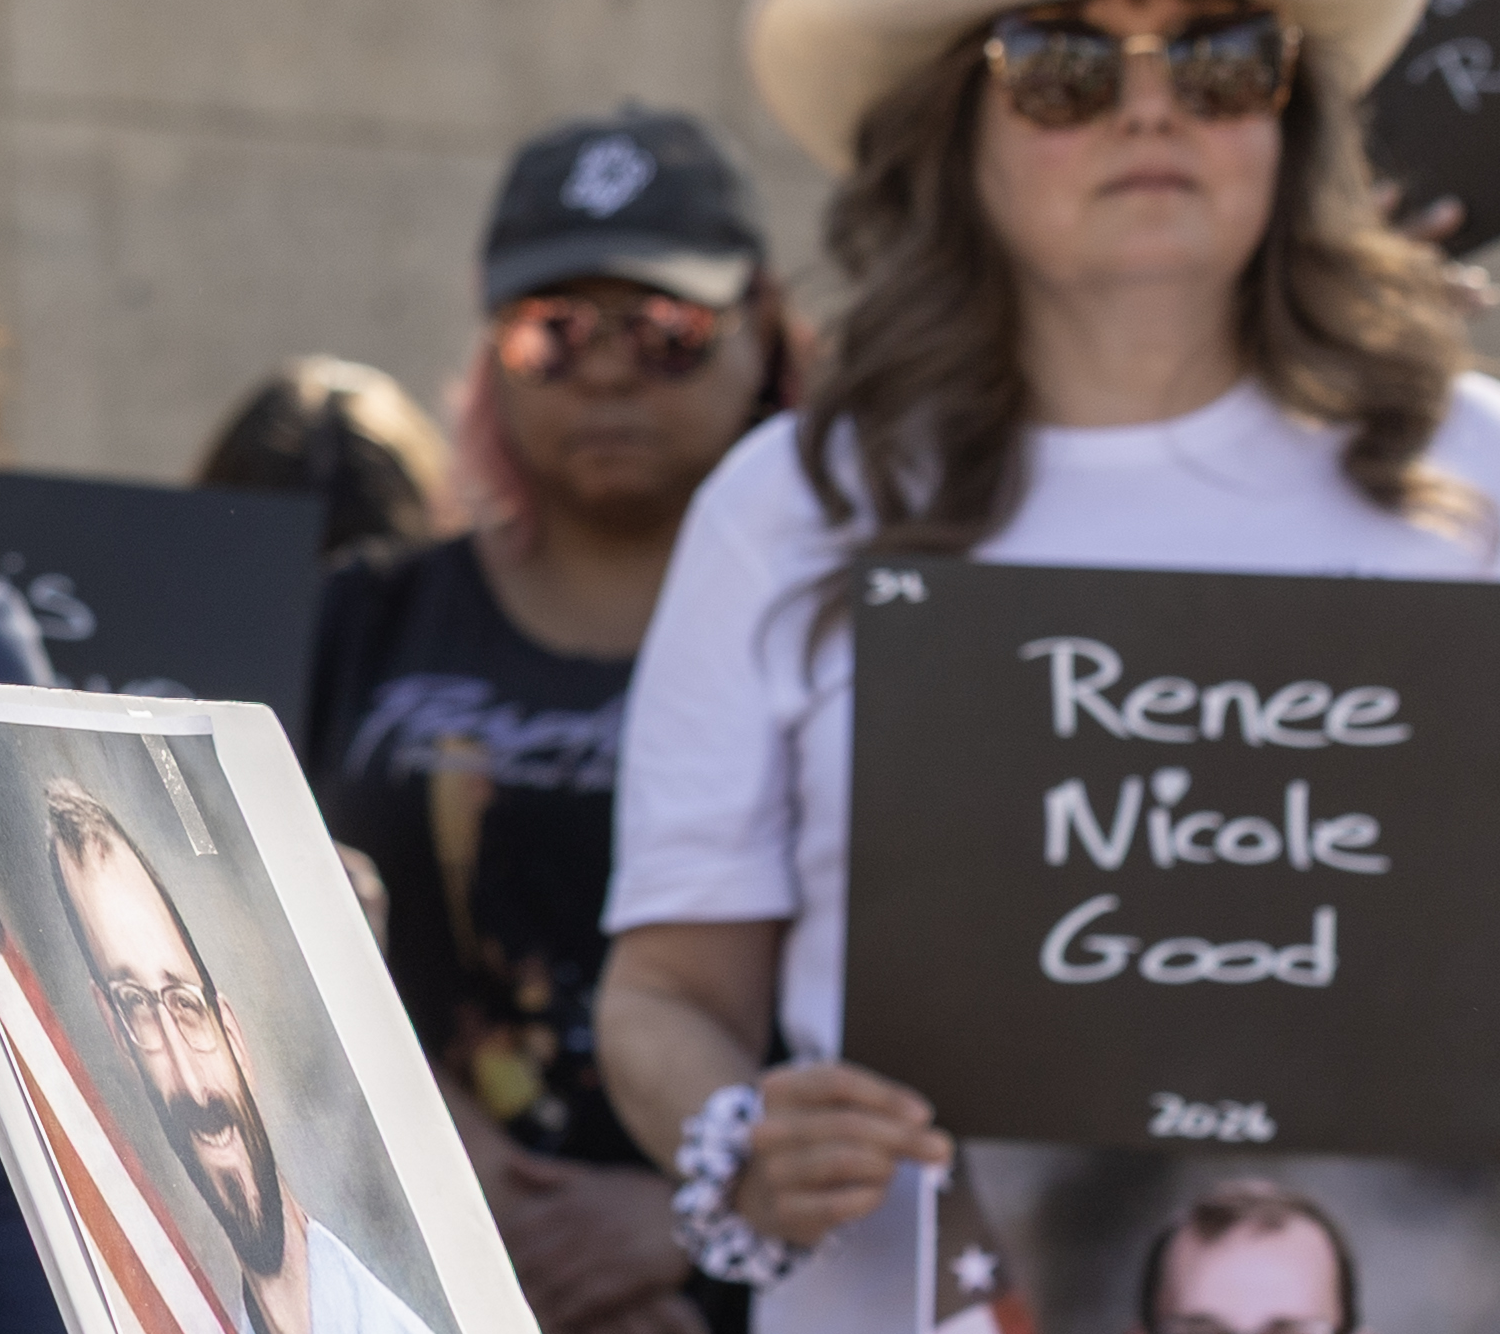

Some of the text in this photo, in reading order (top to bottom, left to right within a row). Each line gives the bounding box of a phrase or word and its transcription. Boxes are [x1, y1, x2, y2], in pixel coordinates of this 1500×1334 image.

[1020, 635, 1412, 749] Renee
[1043, 767, 1390, 874] Nicole
[1040, 894, 1338, 987] Good
[1149, 1092, 1276, 1143] 2026
